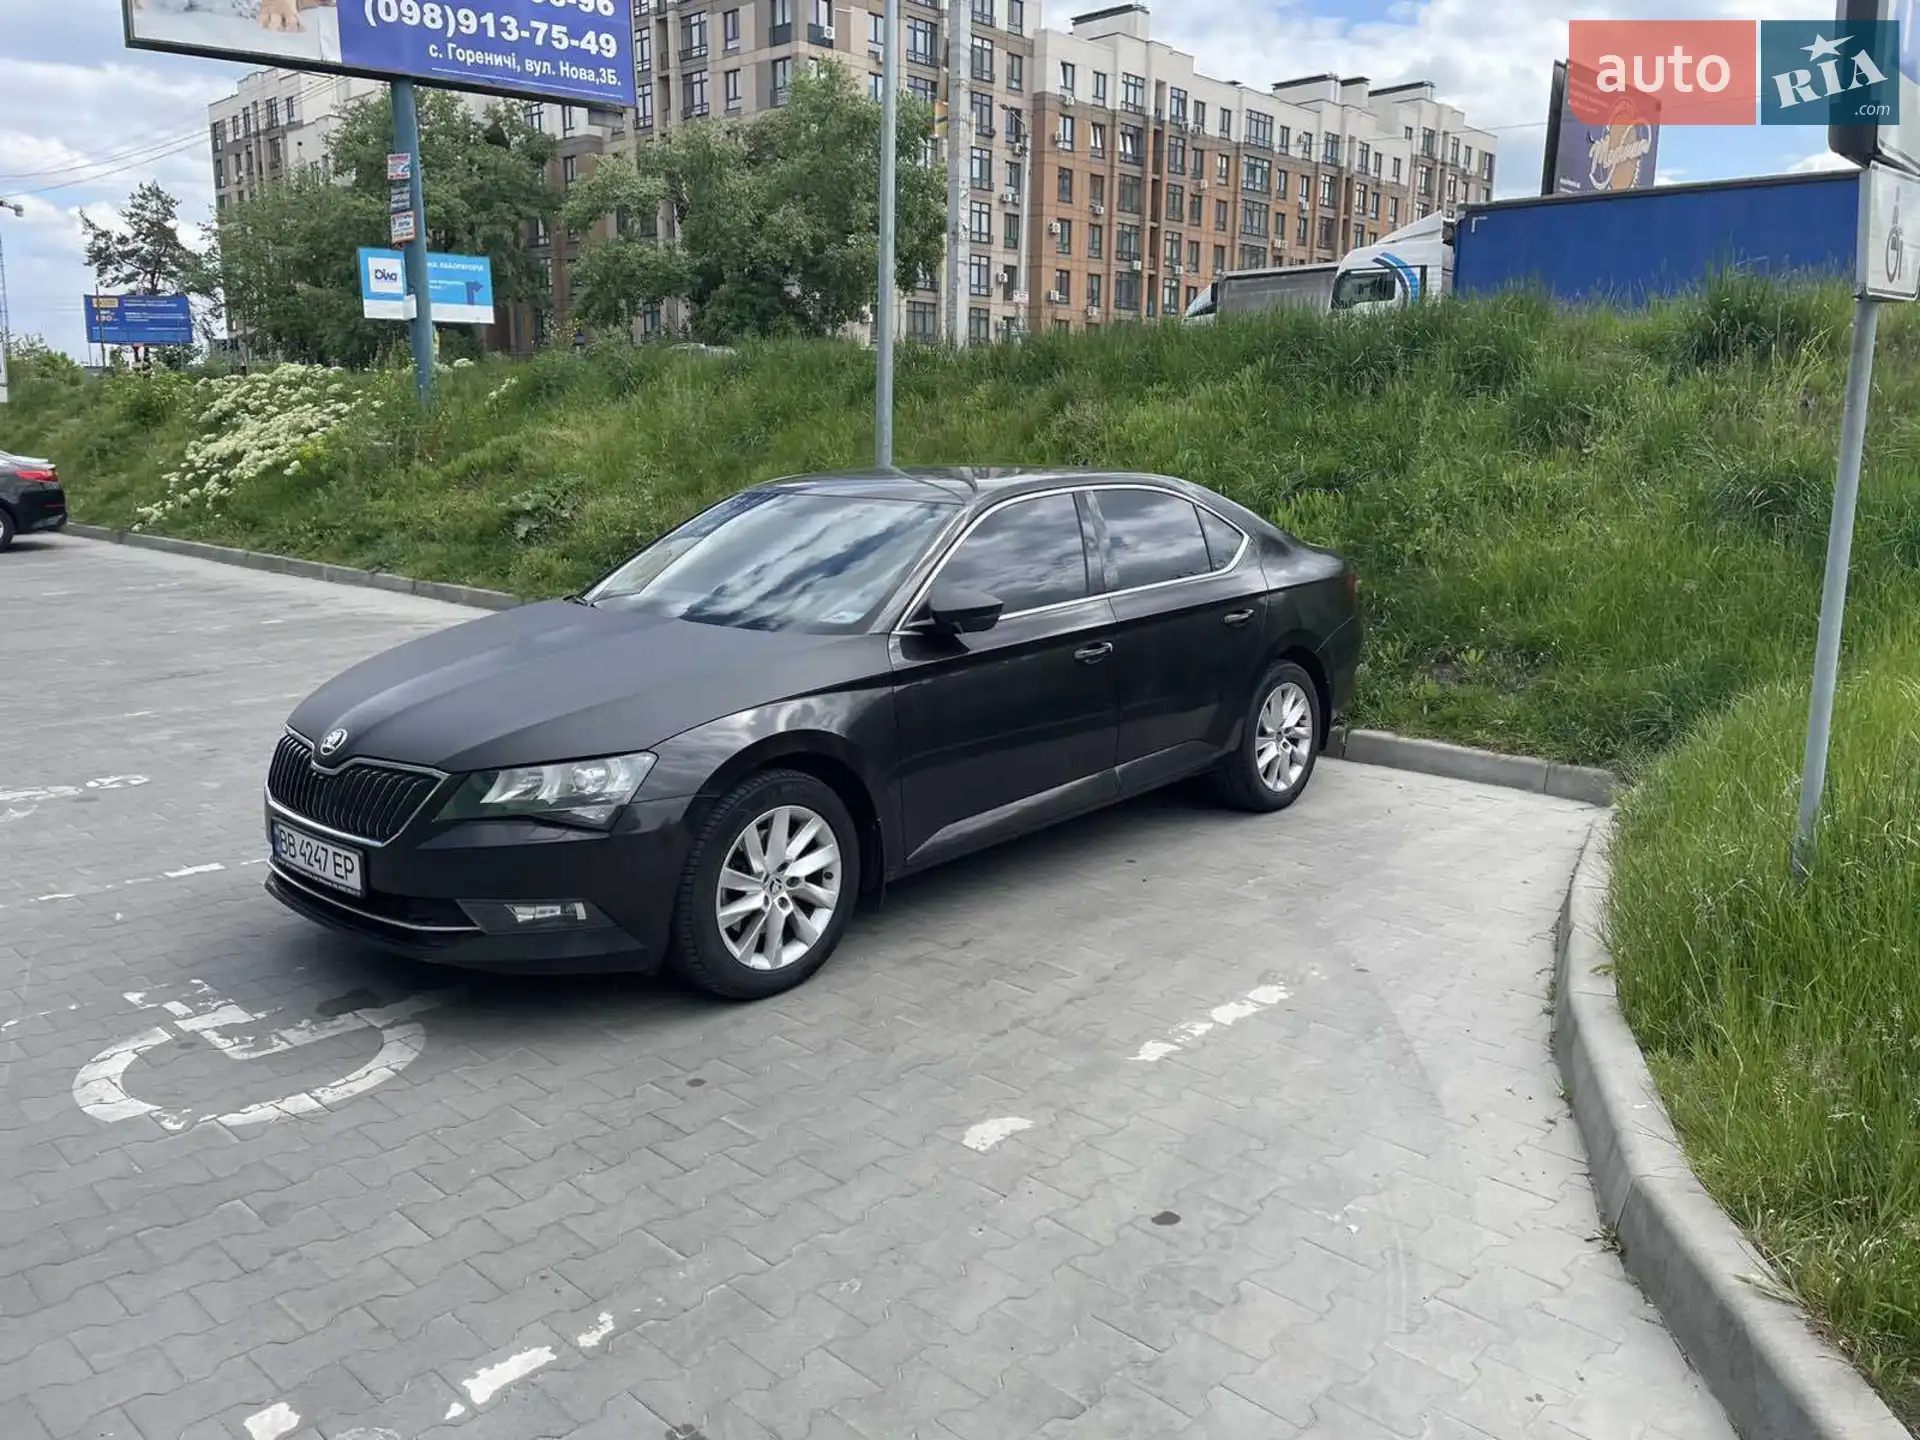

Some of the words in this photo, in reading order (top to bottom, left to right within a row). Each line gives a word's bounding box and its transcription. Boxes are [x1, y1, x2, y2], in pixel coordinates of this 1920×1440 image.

[364, 0, 617, 58] (098)913-75-49
[429, 44, 443, 58] с.
[447, 44, 520, 73] Гореничі,
[525, 58, 555, 77] вул.
[280, 829, 296, 858] BB
[299, 839, 328, 873] 4247
[333, 851, 354, 880] EP
